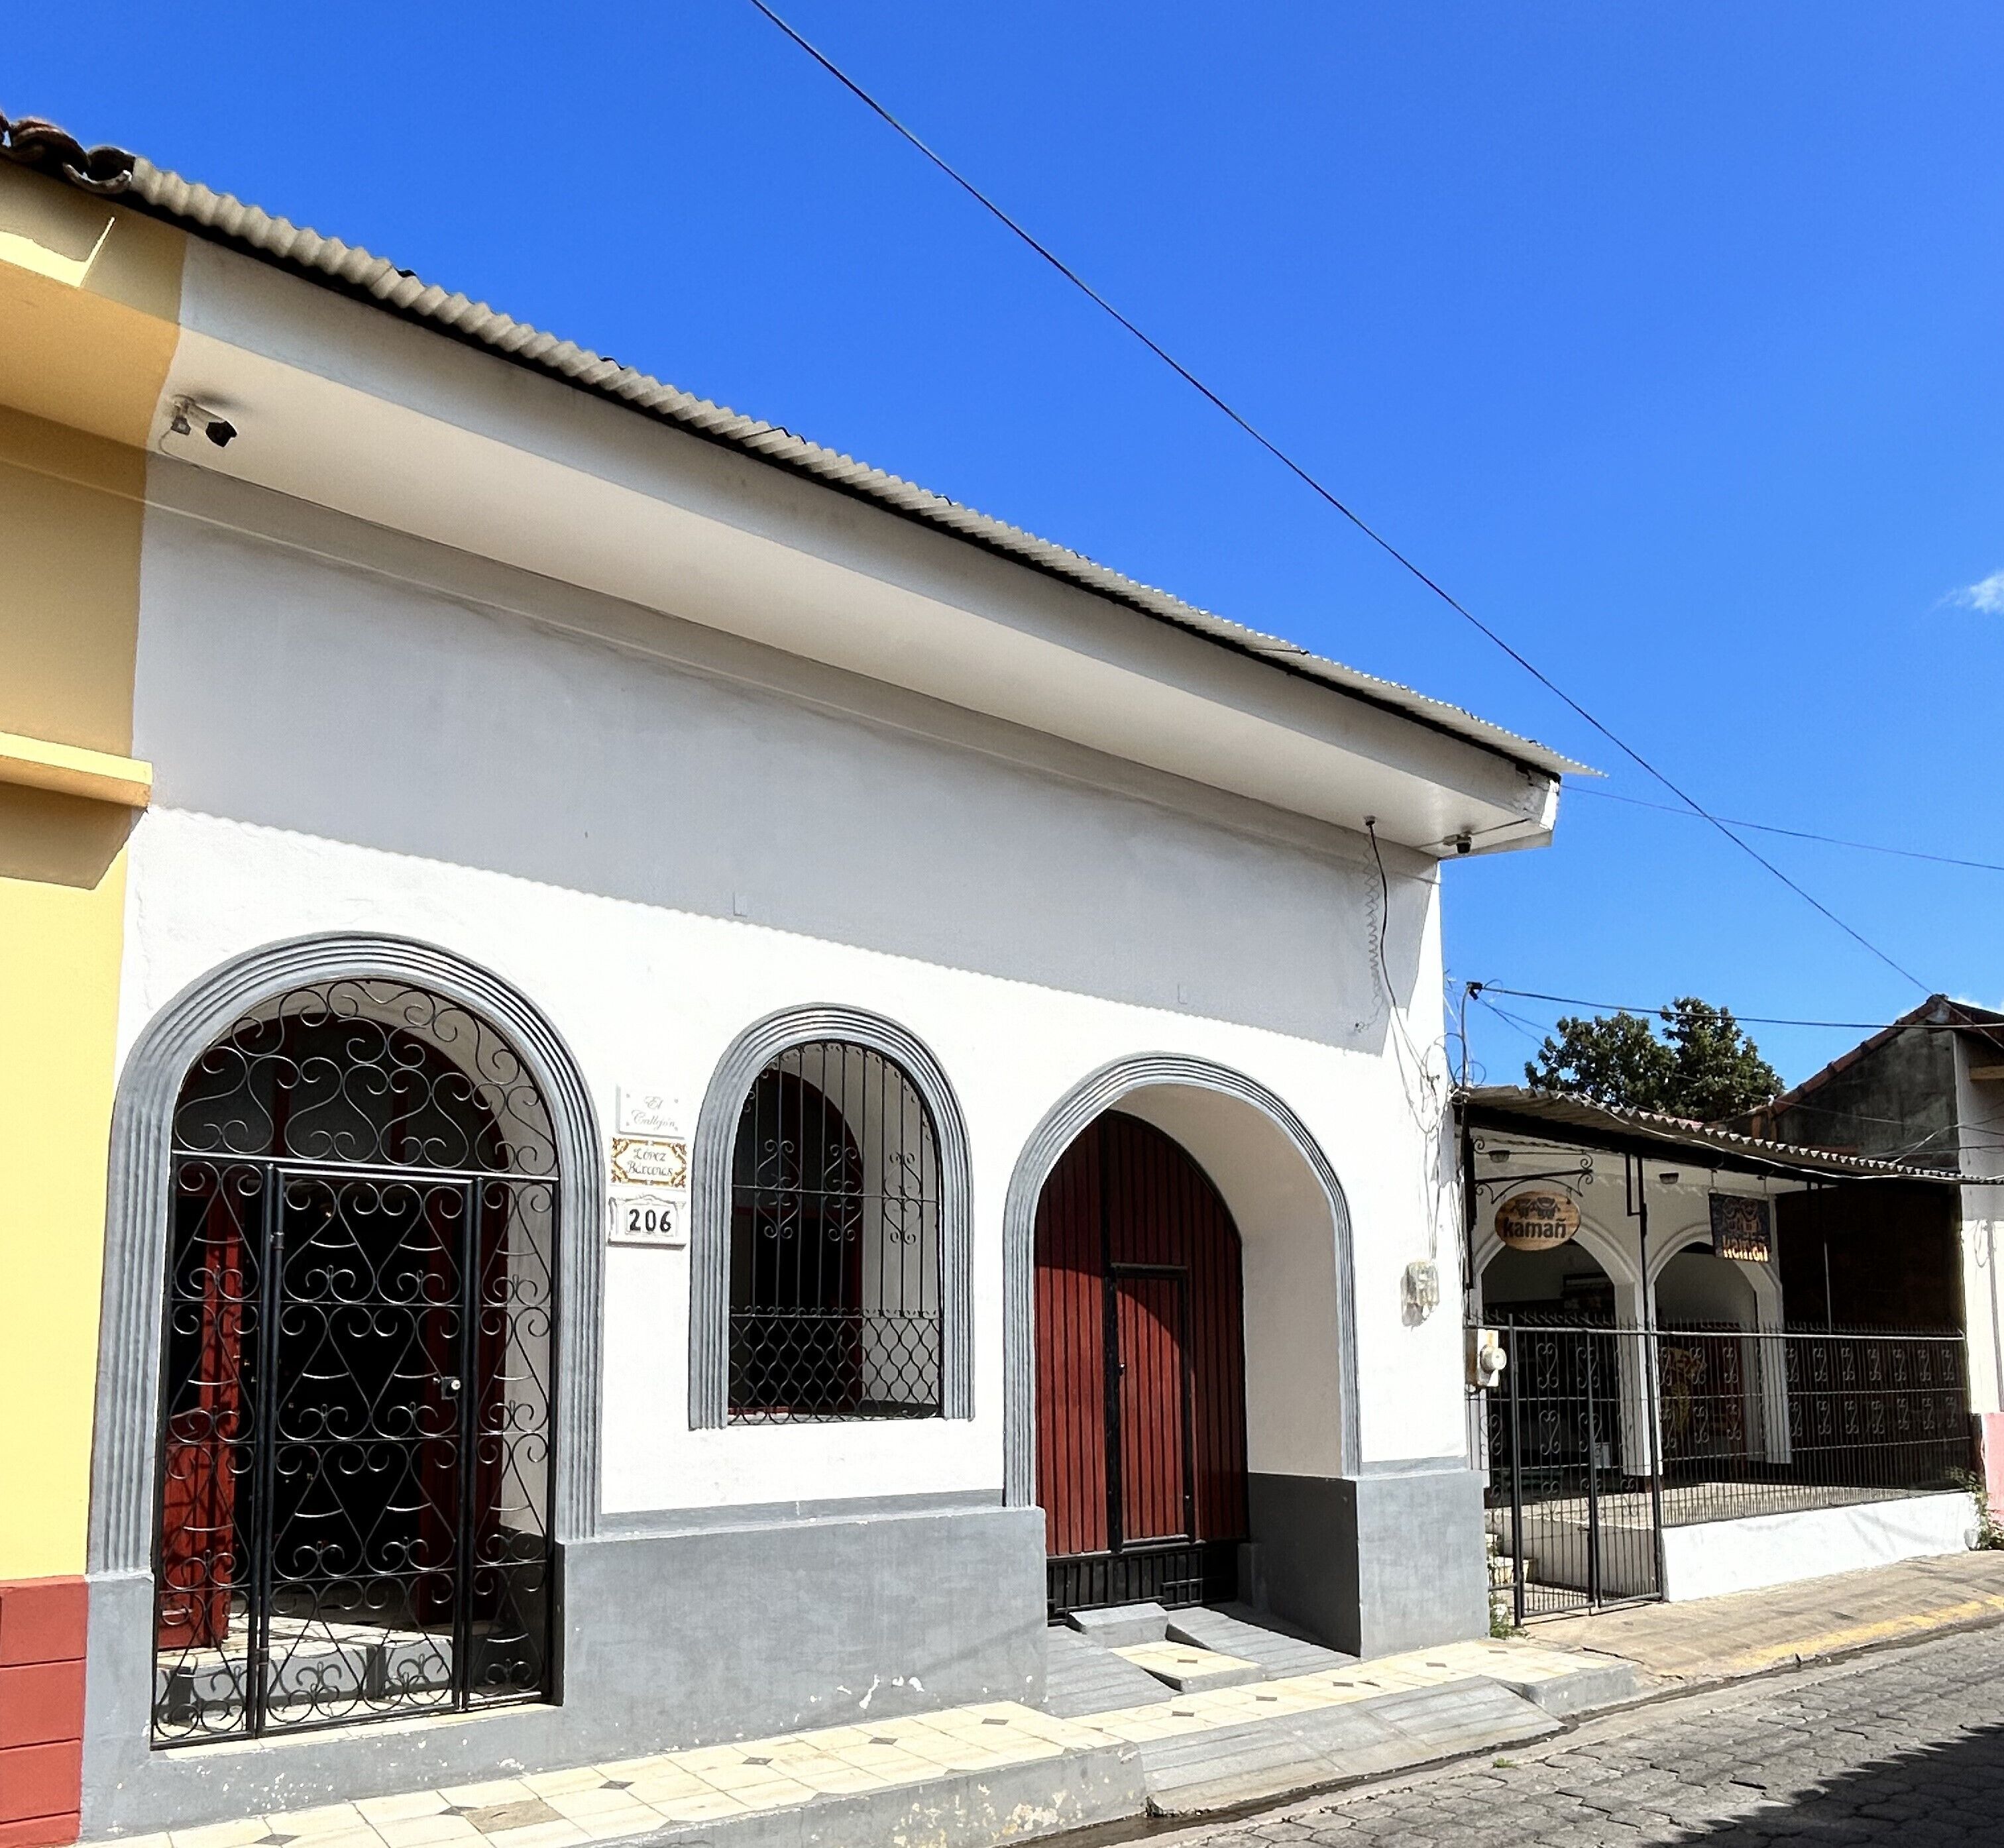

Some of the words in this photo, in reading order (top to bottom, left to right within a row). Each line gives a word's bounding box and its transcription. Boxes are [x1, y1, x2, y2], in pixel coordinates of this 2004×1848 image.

[643, 1096, 663, 1109] El
[629, 1209, 672, 1233] 206
[1503, 1217, 1567, 1238] kamañ
